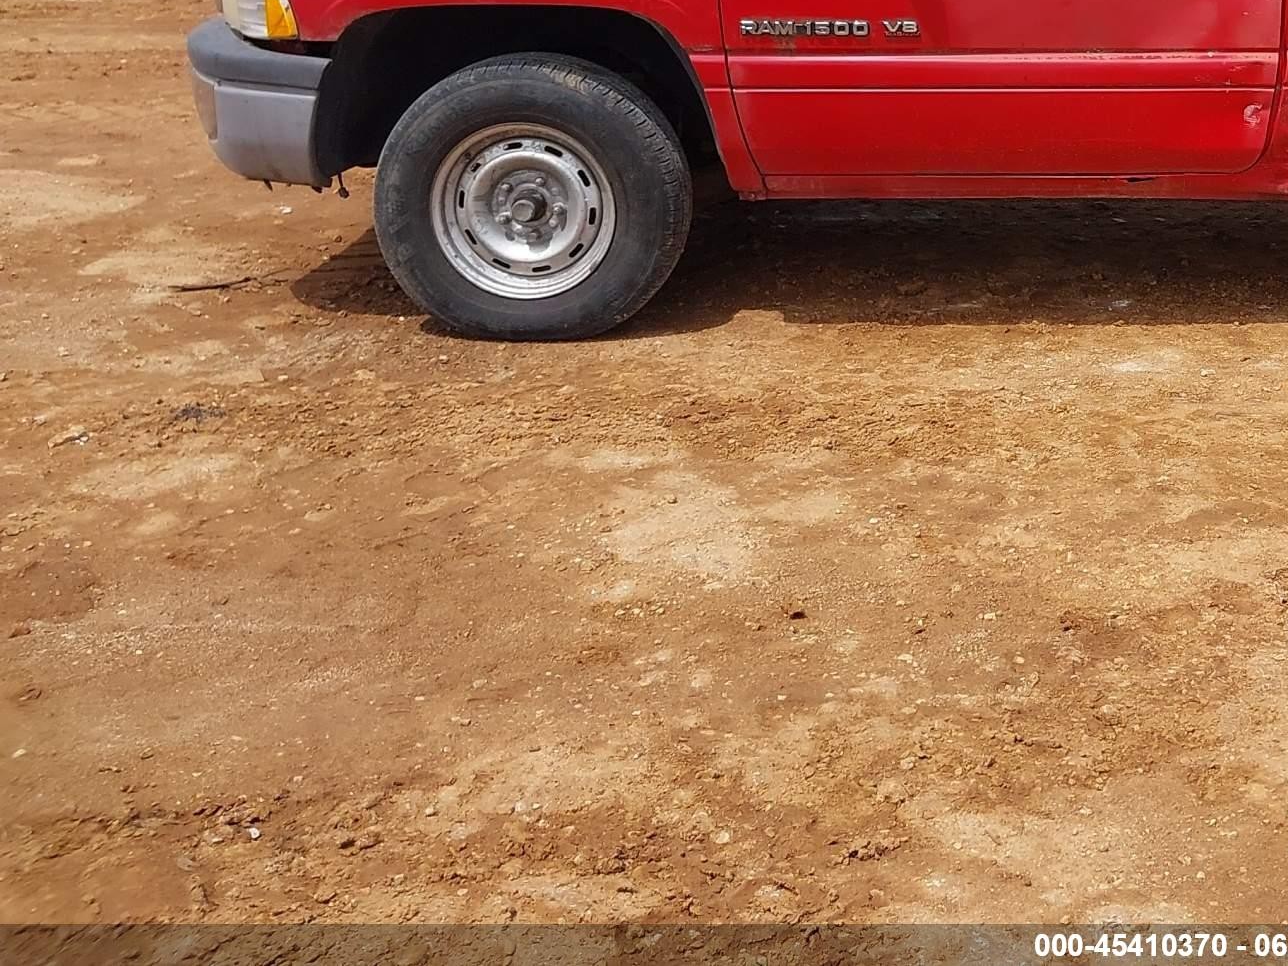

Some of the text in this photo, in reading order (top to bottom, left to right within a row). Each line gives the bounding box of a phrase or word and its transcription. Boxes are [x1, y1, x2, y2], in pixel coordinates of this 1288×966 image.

[740, 19, 918, 36] RAM 1500 V8
